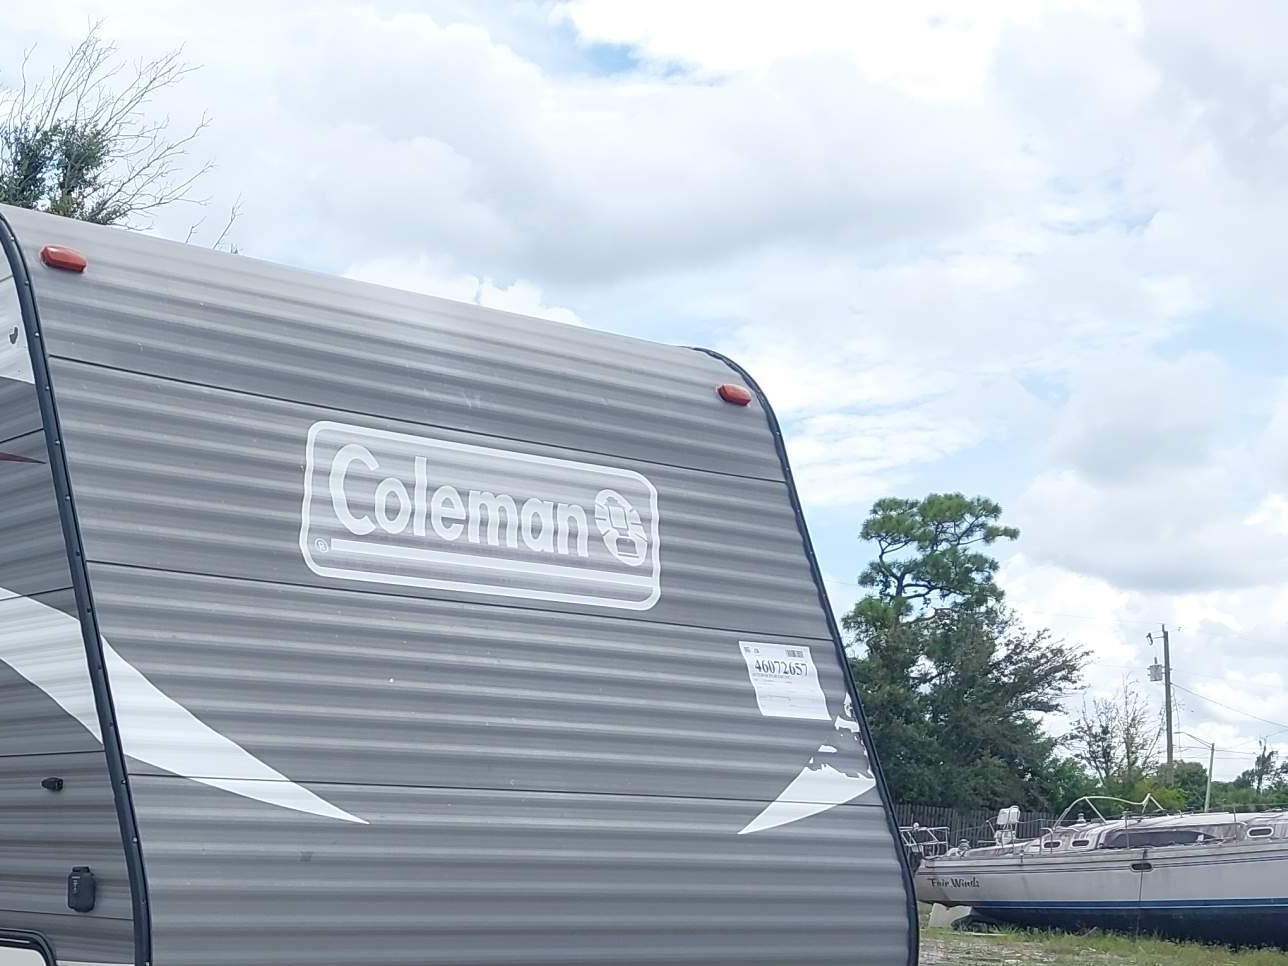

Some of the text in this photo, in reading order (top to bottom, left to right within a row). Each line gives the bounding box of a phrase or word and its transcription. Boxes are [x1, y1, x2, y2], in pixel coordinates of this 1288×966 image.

[328, 443, 589, 558] Coleman
[754, 658, 809, 678] 46072657
[927, 876, 980, 888] Fair Winds
